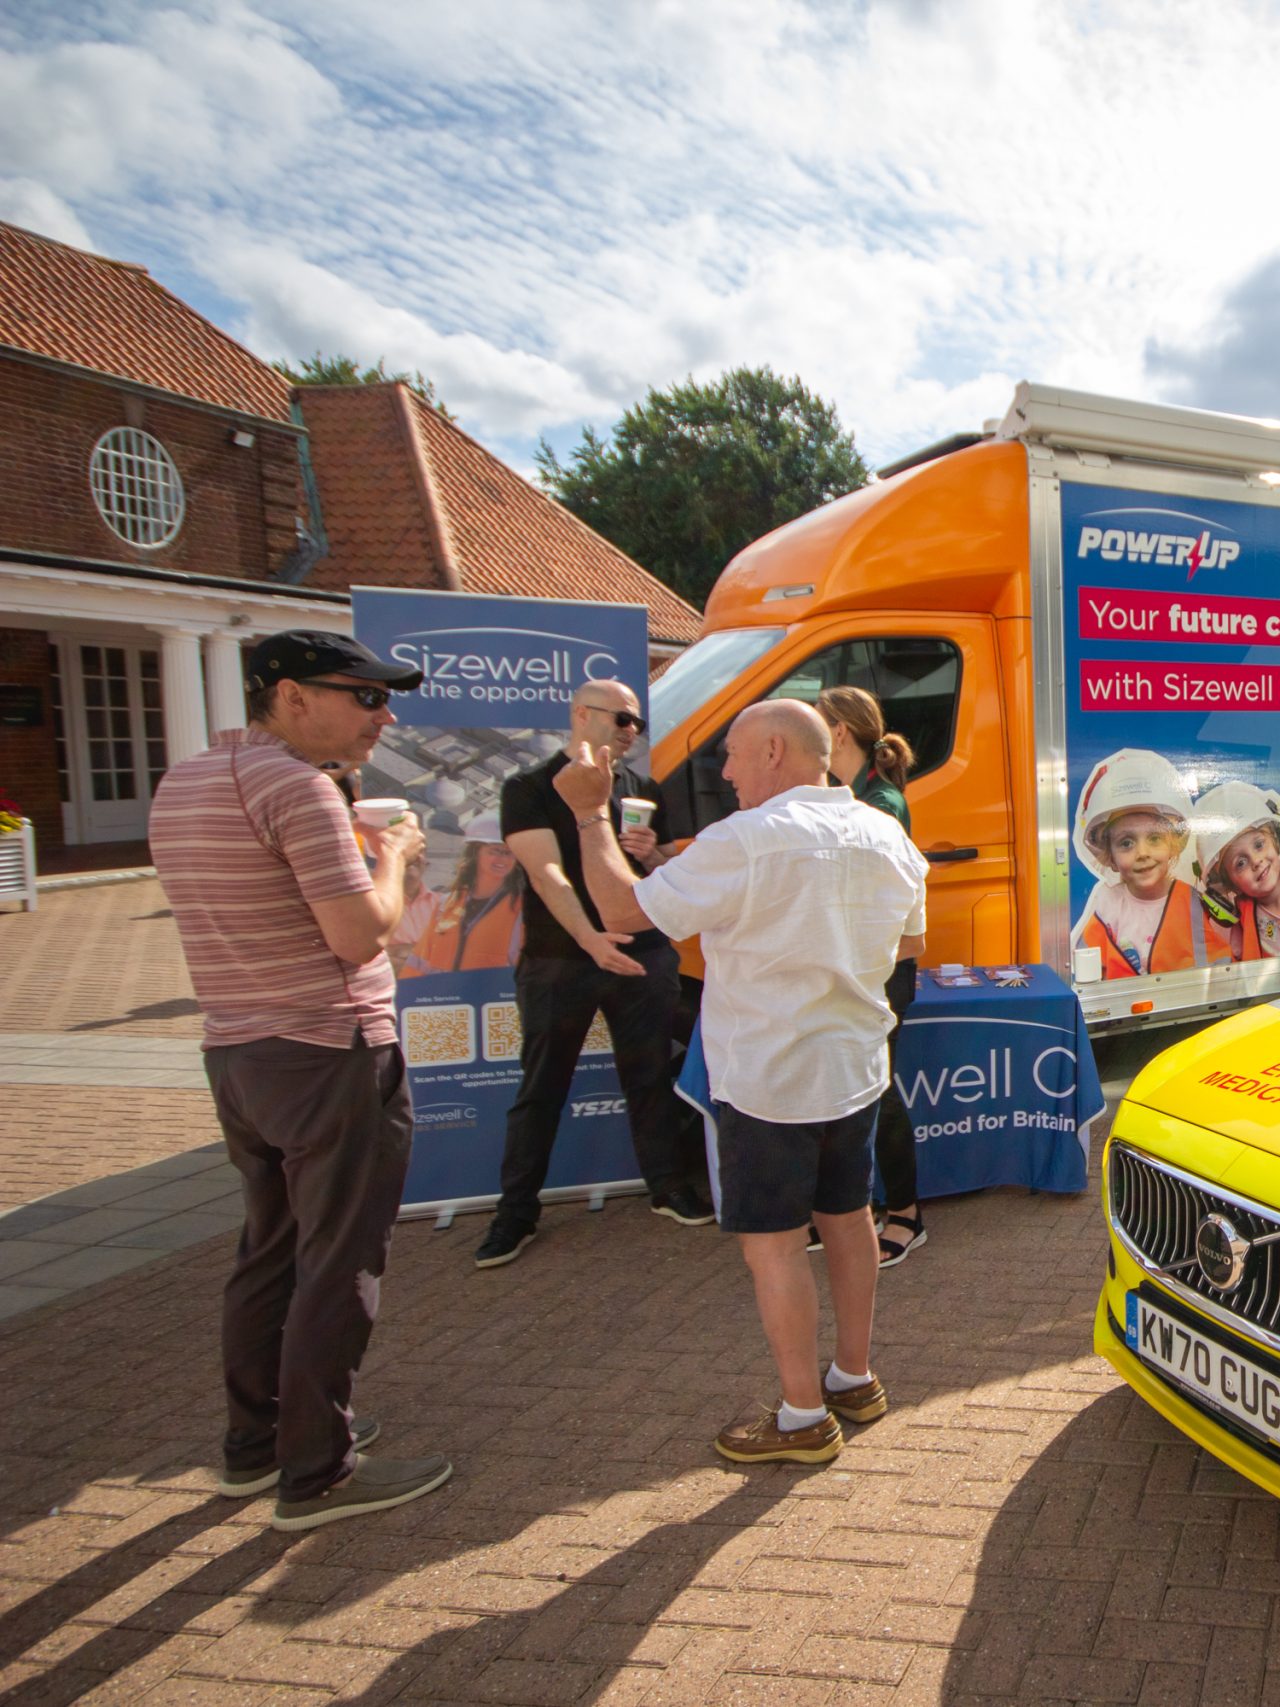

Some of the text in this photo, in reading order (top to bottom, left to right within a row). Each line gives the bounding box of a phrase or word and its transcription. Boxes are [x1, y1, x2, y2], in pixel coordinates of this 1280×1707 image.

[1088, 600, 1160, 631] Your
[1169, 603, 1258, 636] future
[390, 643, 620, 683] Sizewell C
[419, 680, 462, 698] the
[470, 685, 577, 703] opportu
[1087, 671, 1153, 701] with
[1163, 673, 1273, 702] Sizewell
[894, 1046, 1076, 1109] well C
[413, 1107, 477, 1124] izewell C
[914, 1110, 1076, 1142] good for Britain
[1199, 1243, 1231, 1266] VOLVO
[1141, 1307, 1211, 1387] KW70
[1220, 1355, 1280, 1429] CUG
